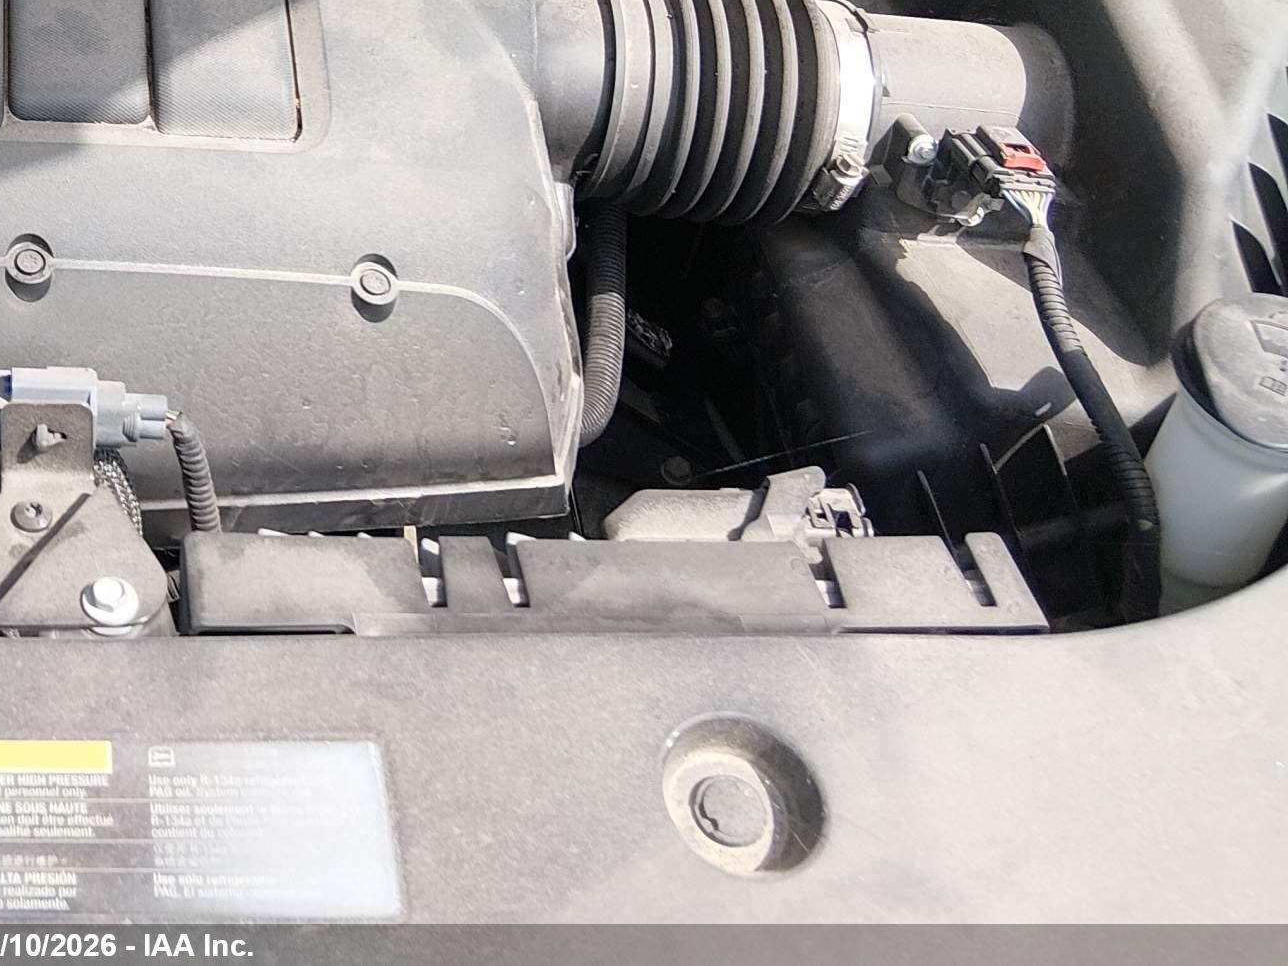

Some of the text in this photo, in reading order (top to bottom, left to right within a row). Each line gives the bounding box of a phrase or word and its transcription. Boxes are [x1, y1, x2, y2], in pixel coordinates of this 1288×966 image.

[17, 774, 47, 786] HIGH
[48, 774, 110, 787] PRESSURE
[148, 774, 171, 786] Use
[172, 775, 197, 788] only
[3, 786, 60, 800] personnel
[148, 785, 173, 797] PAG
[15, 801, 48, 815] SOUS
[49, 801, 88, 815] HAUTE
[17, 814, 40, 826] doit
[150, 814, 192, 826] R-134a
[151, 826, 198, 838] contient
[153, 872, 177, 885] Use
[3, 885, 57, 897] realizado
[58, 886, 77, 899] por
